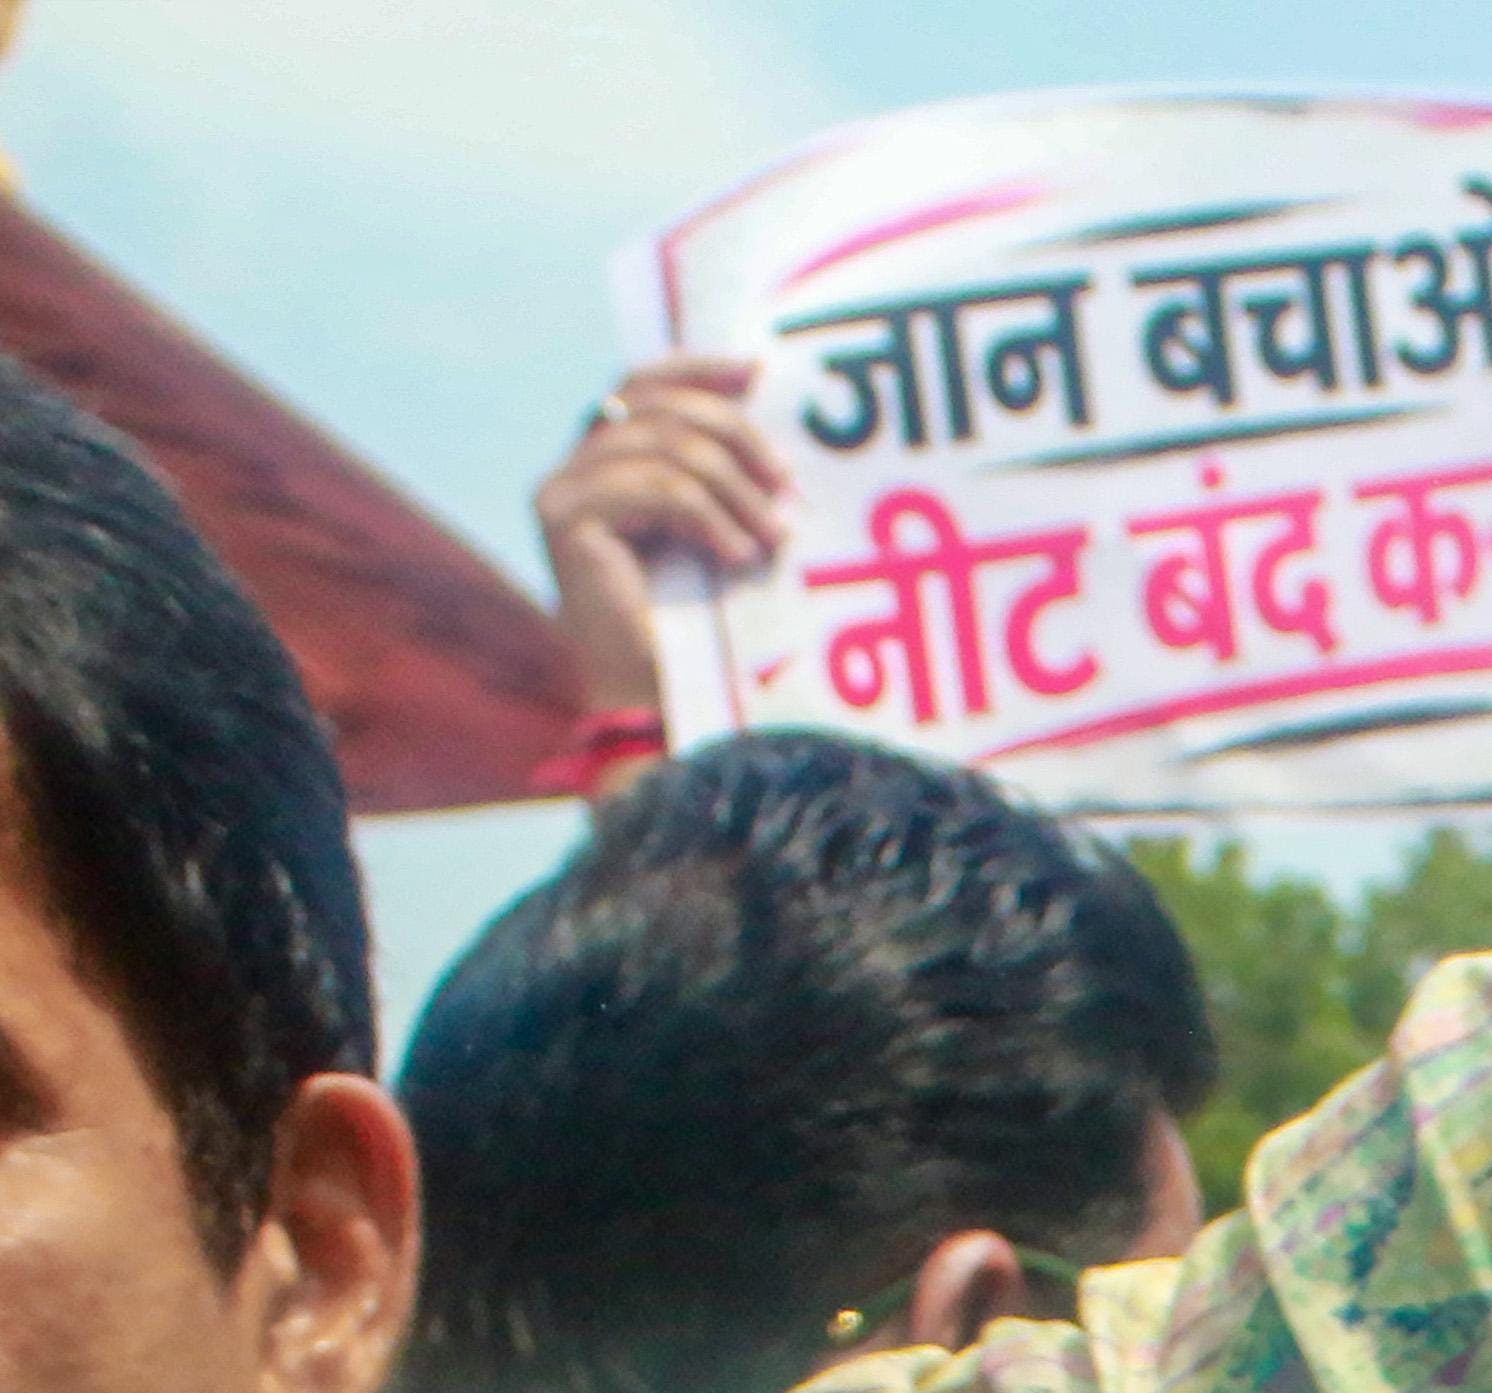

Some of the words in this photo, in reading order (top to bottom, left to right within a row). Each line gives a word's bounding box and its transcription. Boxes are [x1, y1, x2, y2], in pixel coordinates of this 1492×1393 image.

[773, 269, 1092, 455] जान
[802, 486, 1101, 727] नीट
[1126, 462, 1340, 666] बंद
